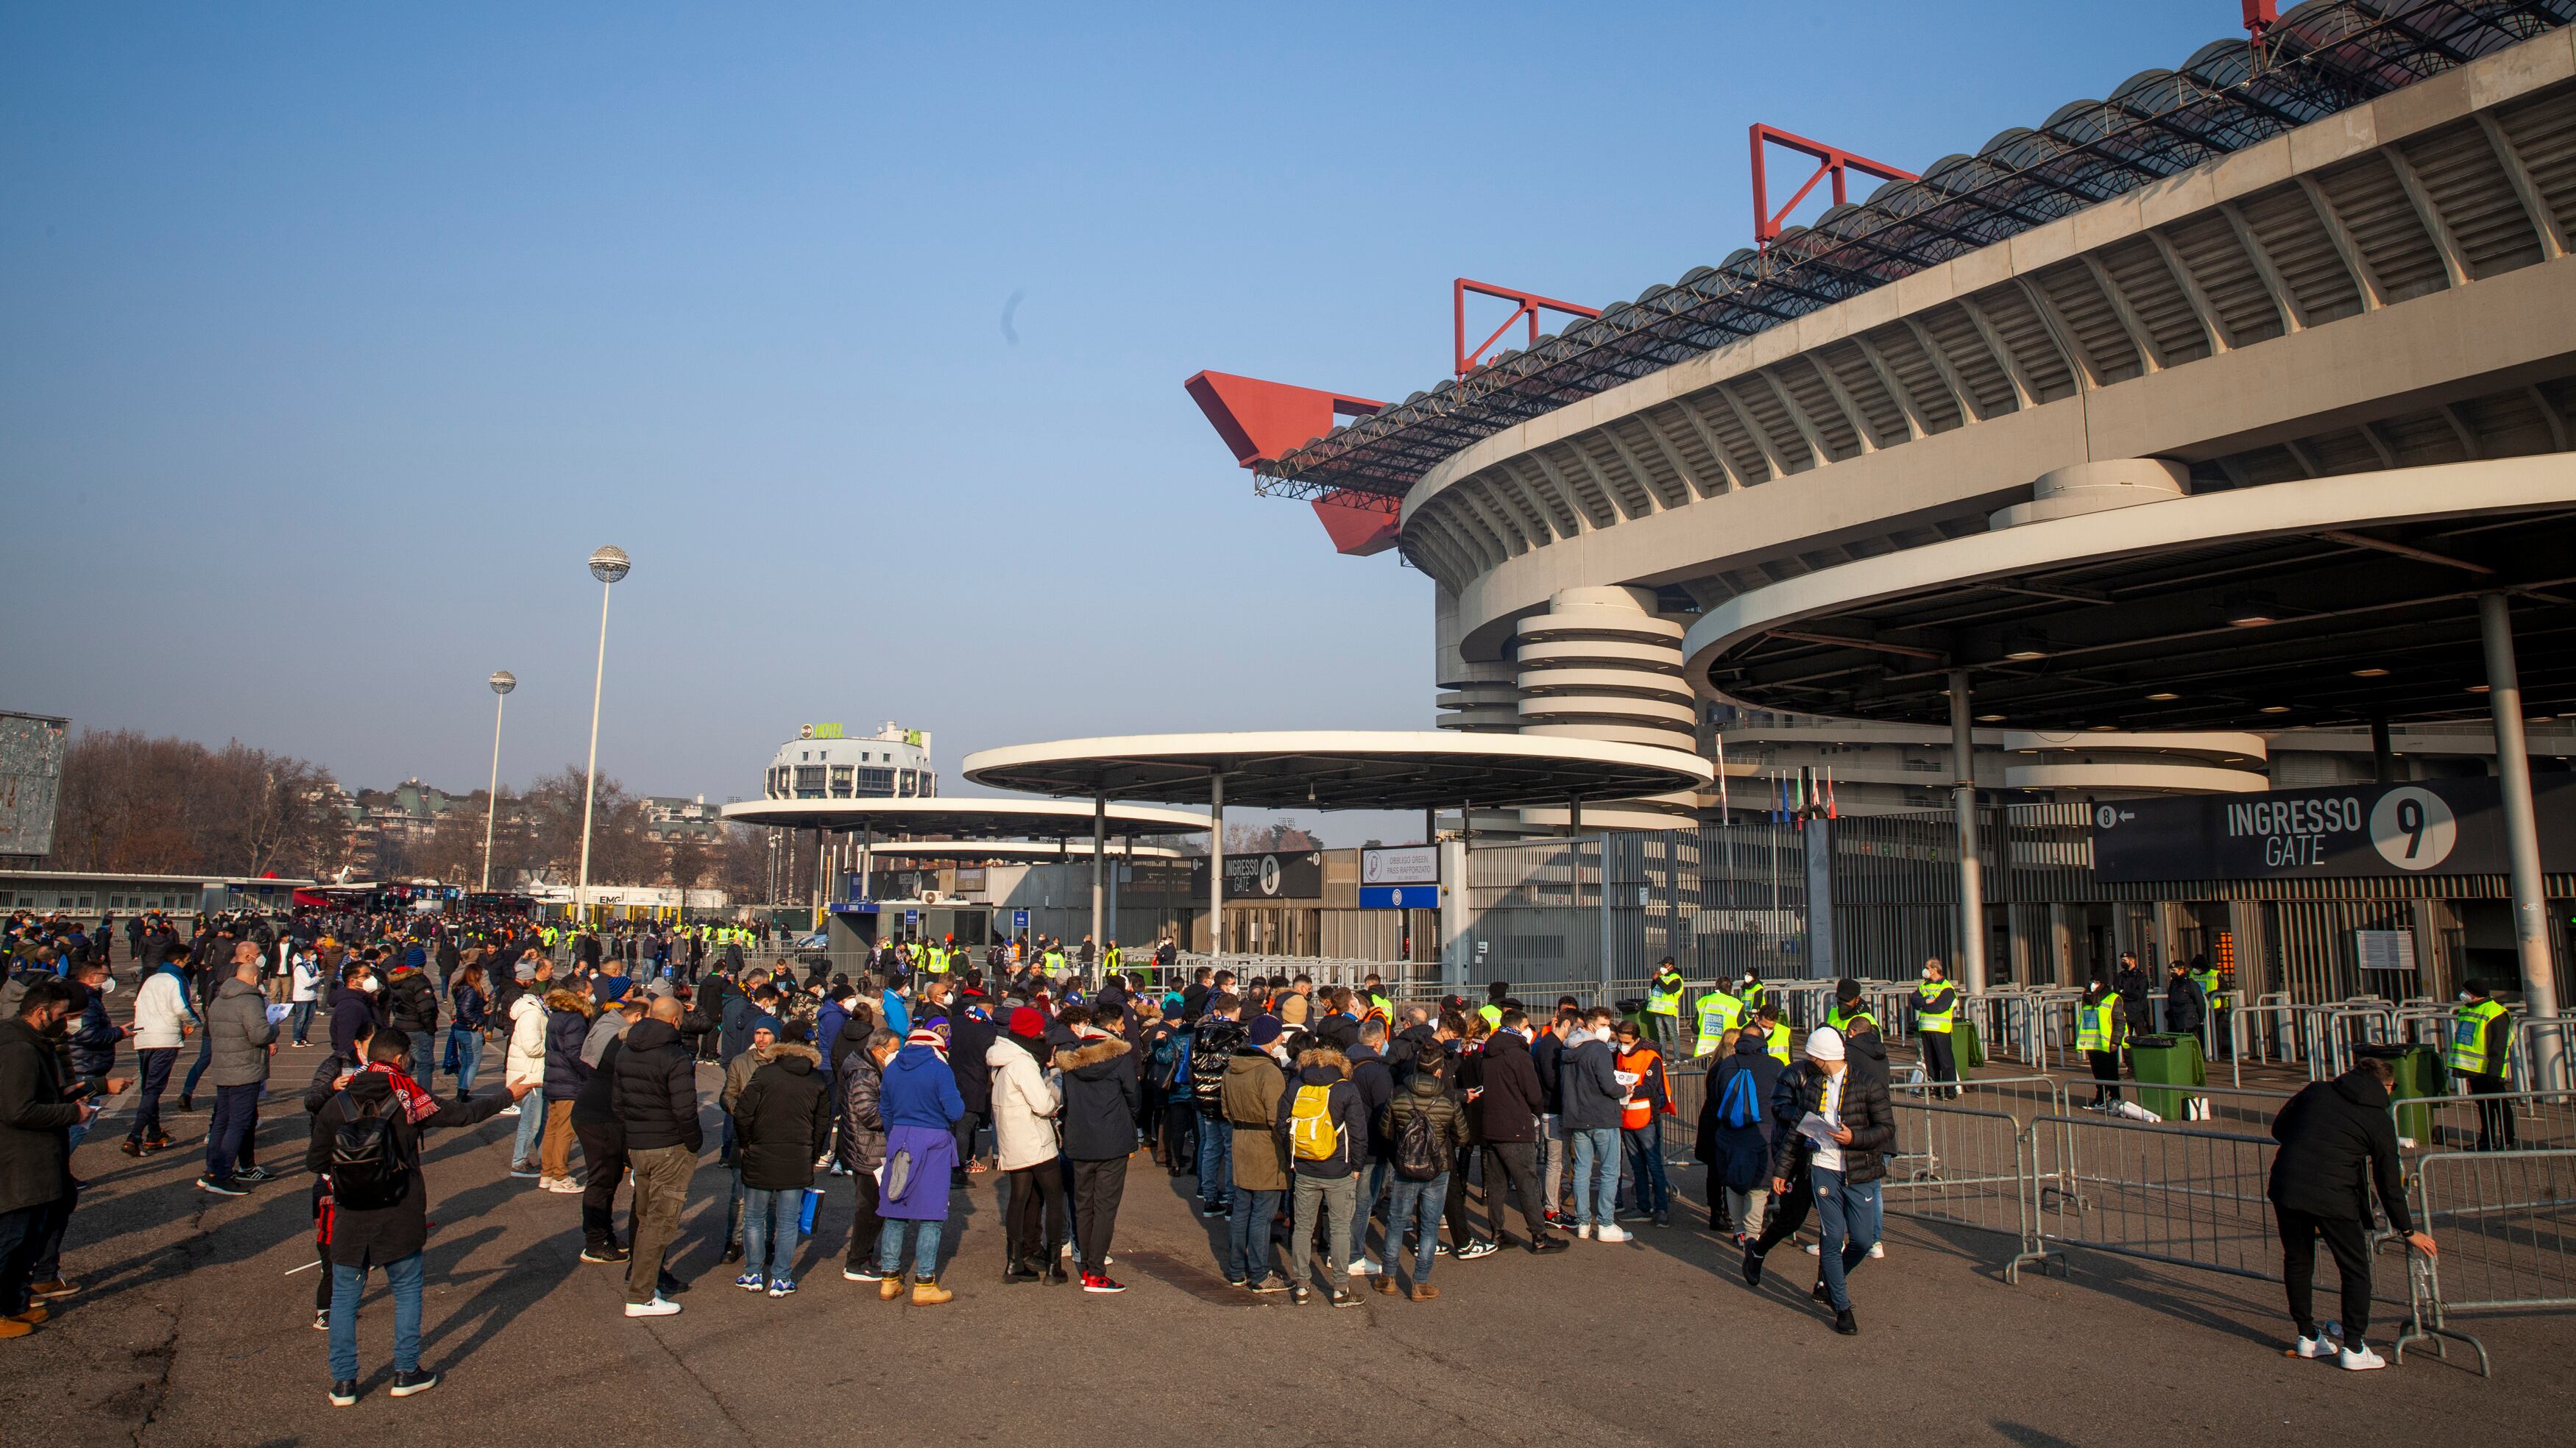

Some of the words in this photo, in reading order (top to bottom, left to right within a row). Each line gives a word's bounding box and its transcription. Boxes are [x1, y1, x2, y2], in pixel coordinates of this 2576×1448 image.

[815, 723, 843, 738] HOTEL
[2103, 809, 2110, 825] 8
[2227, 797, 2361, 837] INGRESSO
[2396, 798, 2425, 859] 9
[2265, 834, 2326, 867] GATE
[1226, 859, 1259, 876] INGRESSO
[1412, 856, 1429, 864] GREEN
[1267, 860, 1273, 890] 8
[1400, 866, 1431, 874] RAFFORZATO
[1234, 876, 1250, 892] GATE
[1707, 1026, 1722, 1035] 2239
